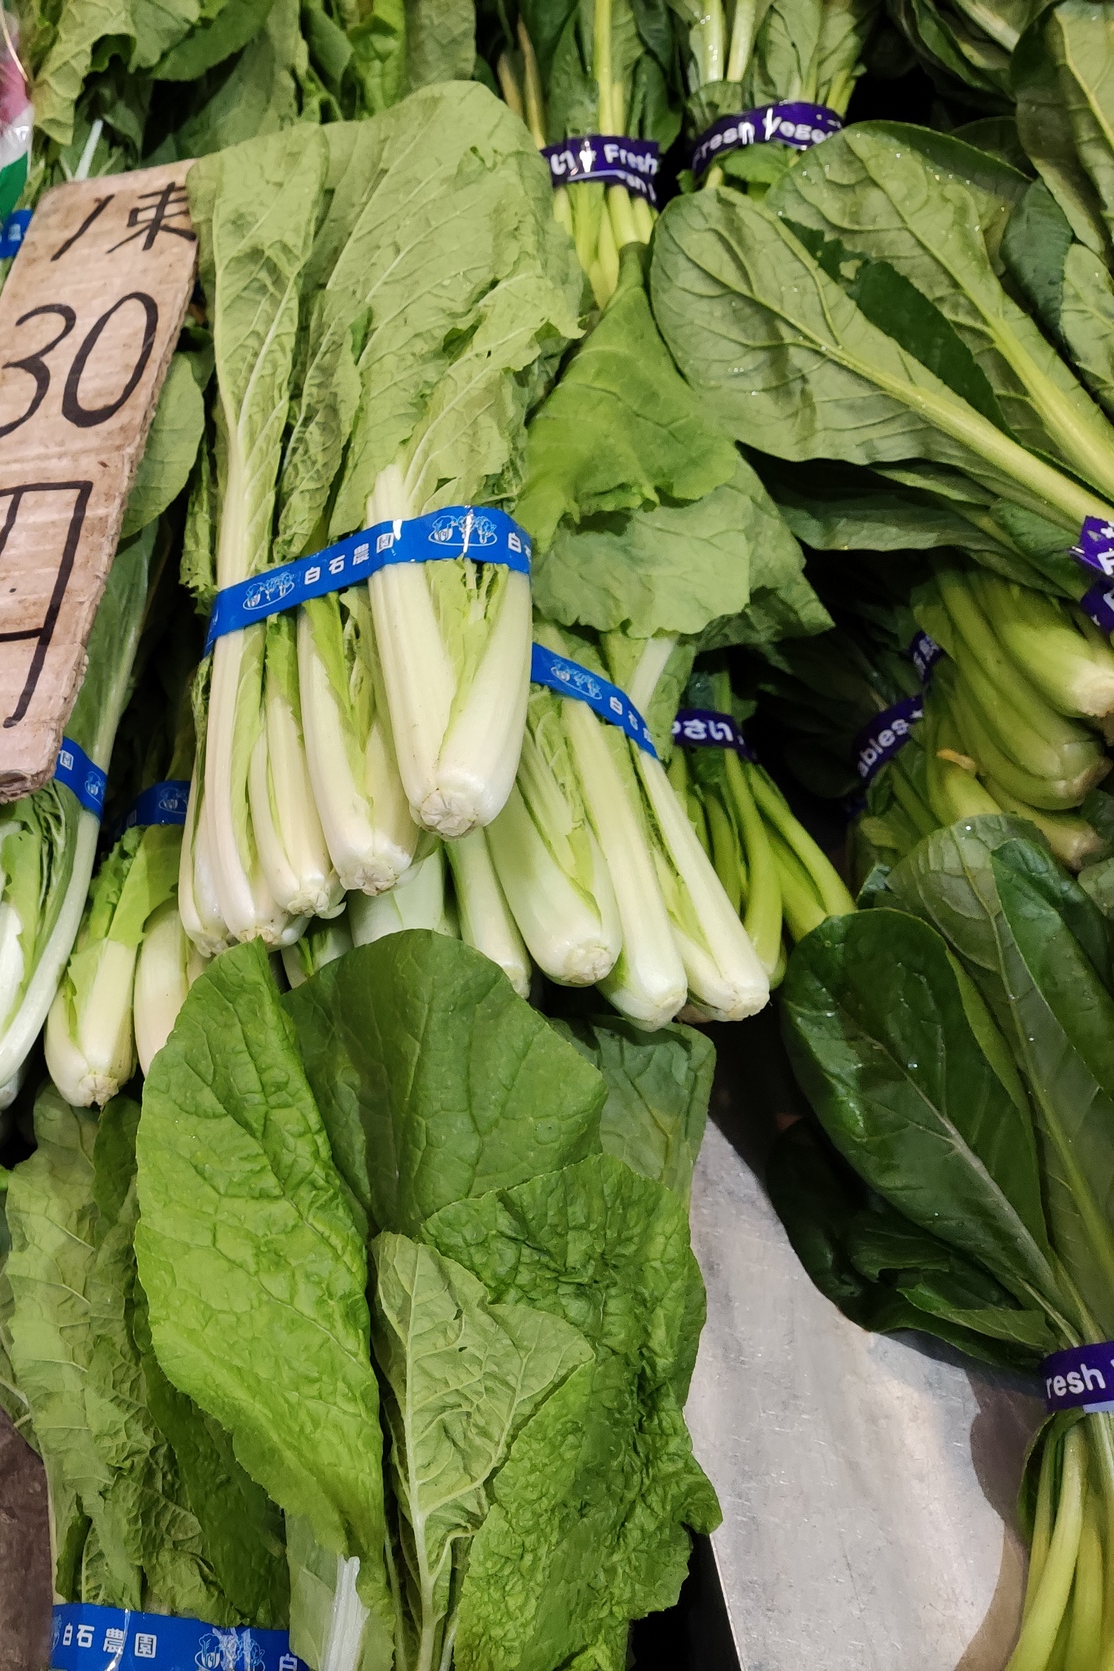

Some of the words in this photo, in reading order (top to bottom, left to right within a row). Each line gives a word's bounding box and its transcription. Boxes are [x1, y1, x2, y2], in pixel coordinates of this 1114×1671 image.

[603, 144, 659, 176] Fresh
[303, 532, 394, 585] 白石農園
[62, 1621, 158, 1659] 白石農園
